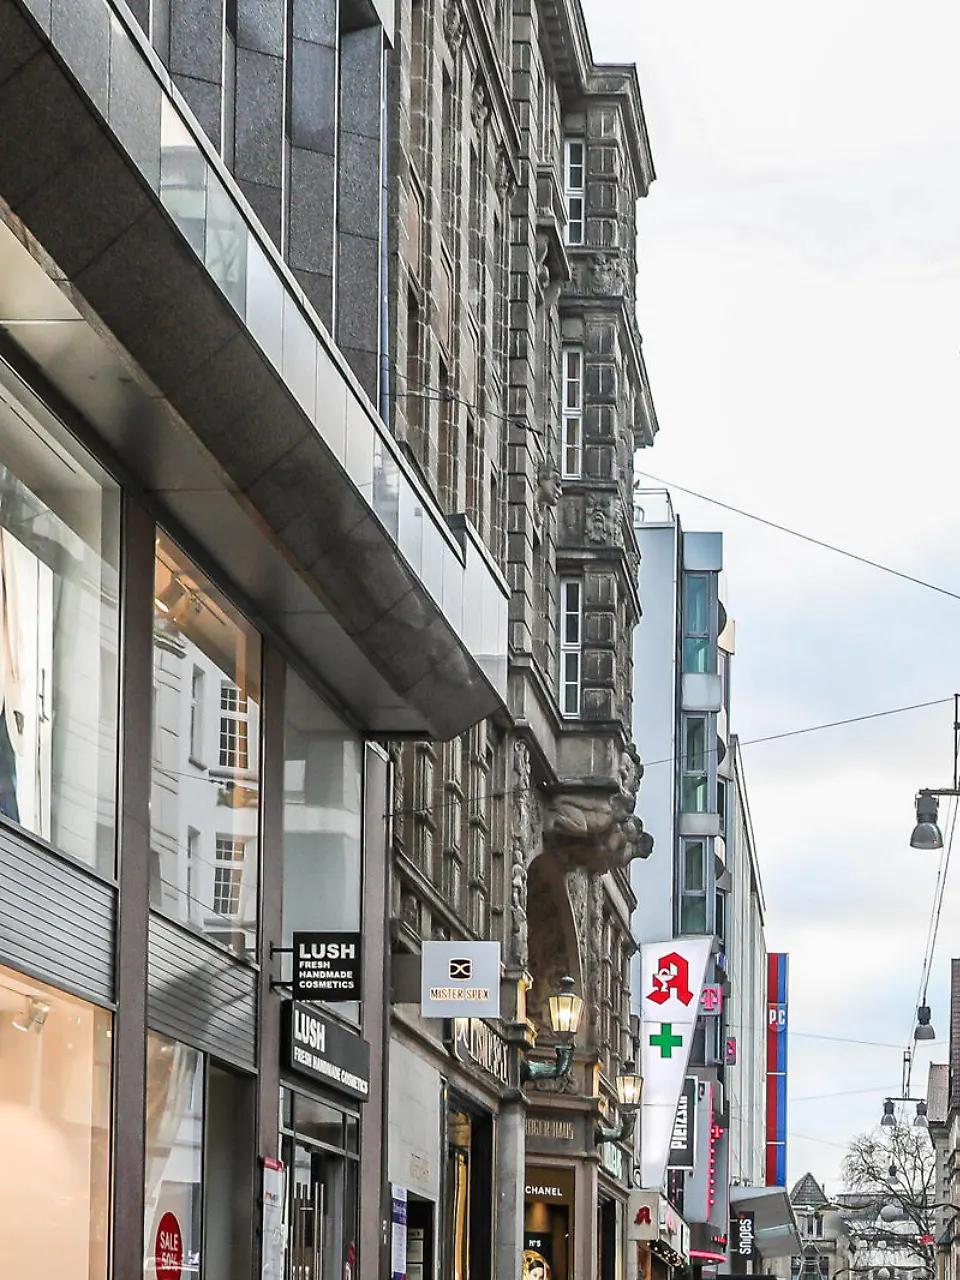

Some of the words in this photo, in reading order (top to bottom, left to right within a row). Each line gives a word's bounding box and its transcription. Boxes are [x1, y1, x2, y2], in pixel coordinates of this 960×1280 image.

[299, 943, 355, 959] LUSH
[299, 960, 331, 969] FRESH
[299, 971, 353, 979] HANDMADE
[299, 980, 354, 989] COSMETICS
[430, 987, 464, 1000] MISTER
[466, 987, 490, 1000] SPEX
[294, 1010, 326, 1053] LUSH
[294, 1046, 312, 1067] FRESH
[312, 1055, 341, 1081] HANDMADE
[341, 1069, 368, 1095] COSMETICS
[525, 1186, 562, 1196] CHANEL
[160, 1230, 178, 1251] SALE
[740, 1219, 754, 1255] snipes
